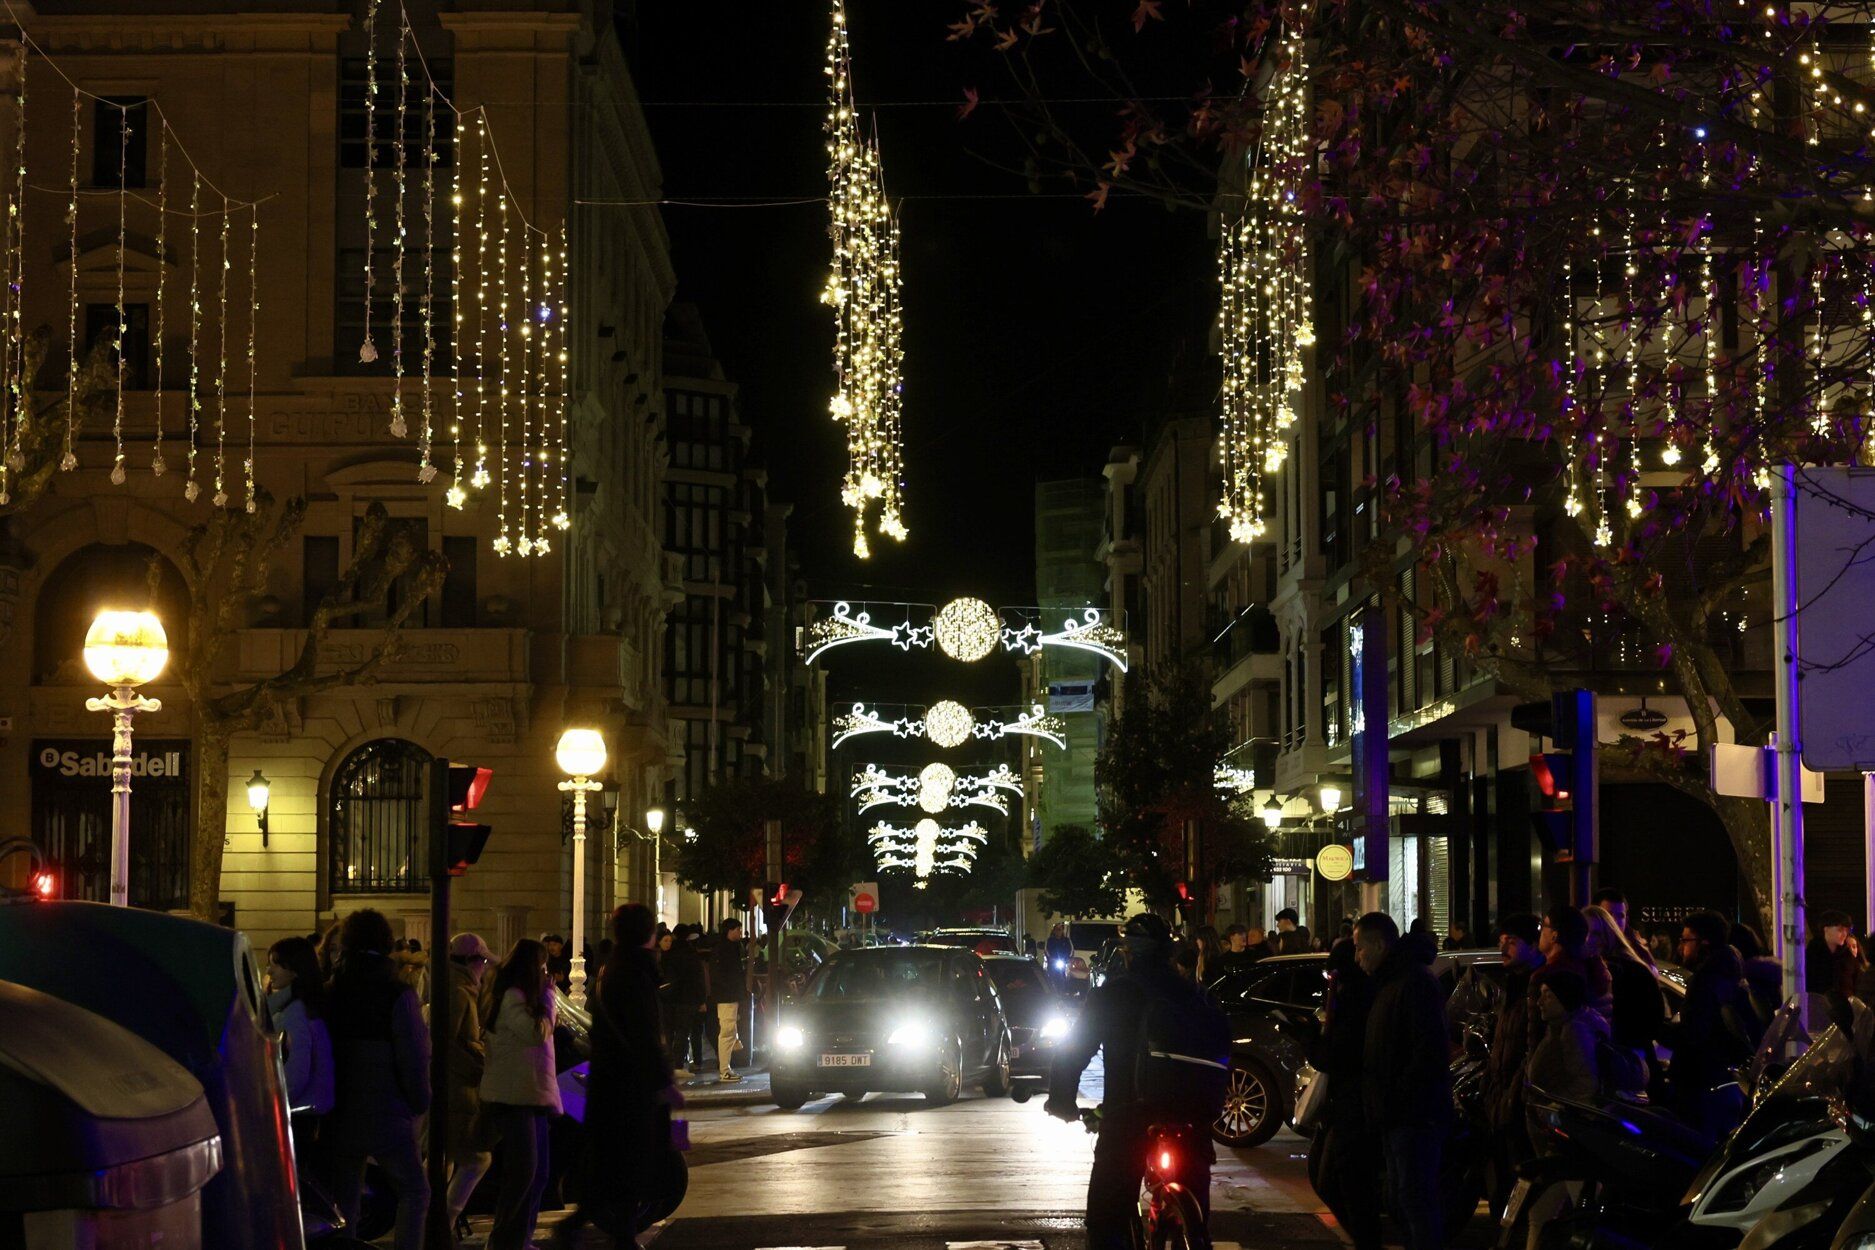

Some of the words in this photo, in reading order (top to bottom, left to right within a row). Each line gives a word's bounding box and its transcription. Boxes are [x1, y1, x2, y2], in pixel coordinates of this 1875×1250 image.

[59, 751, 180, 777] Sabdell
[1640, 906, 1706, 923] SUARE
[824, 1056, 847, 1066] 9185
